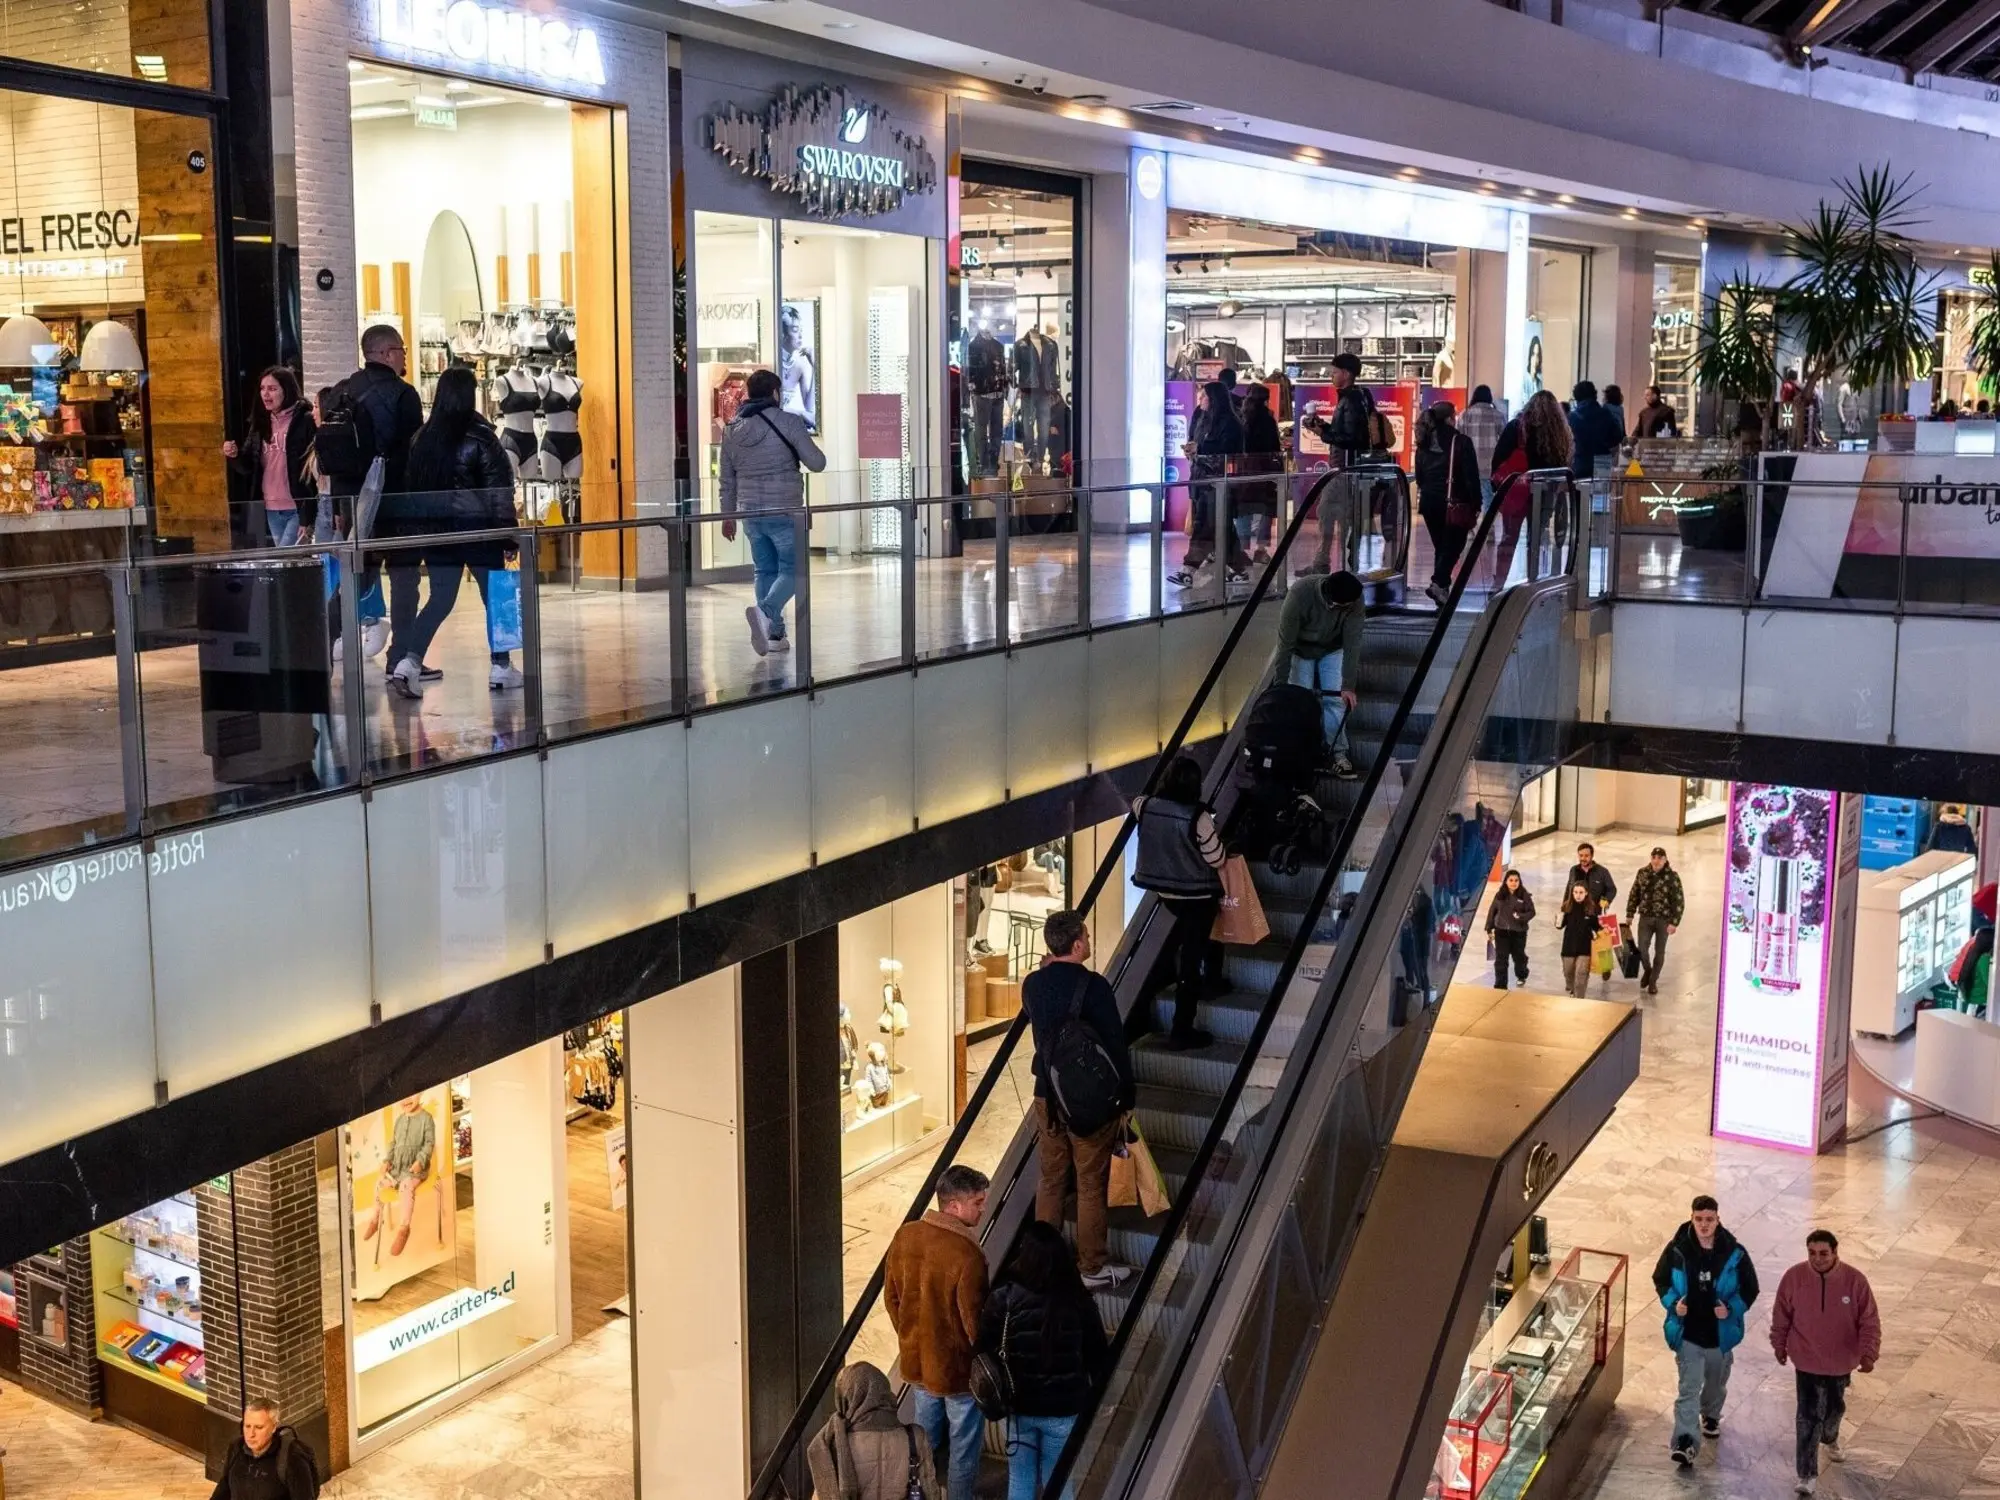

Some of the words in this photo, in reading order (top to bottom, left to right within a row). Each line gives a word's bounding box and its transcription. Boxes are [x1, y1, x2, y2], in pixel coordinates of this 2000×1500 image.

[379, 0, 606, 85] LEONISA
[190, 156, 205, 167] 405
[802, 144, 903, 187] SWAROVSKI
[0, 217, 34, 254] EL
[1725, 1030, 1812, 1055] THIAMIDOL
[1725, 1053, 1739, 1065] #1
[389, 1270, 515, 1351] www.carters.cl
